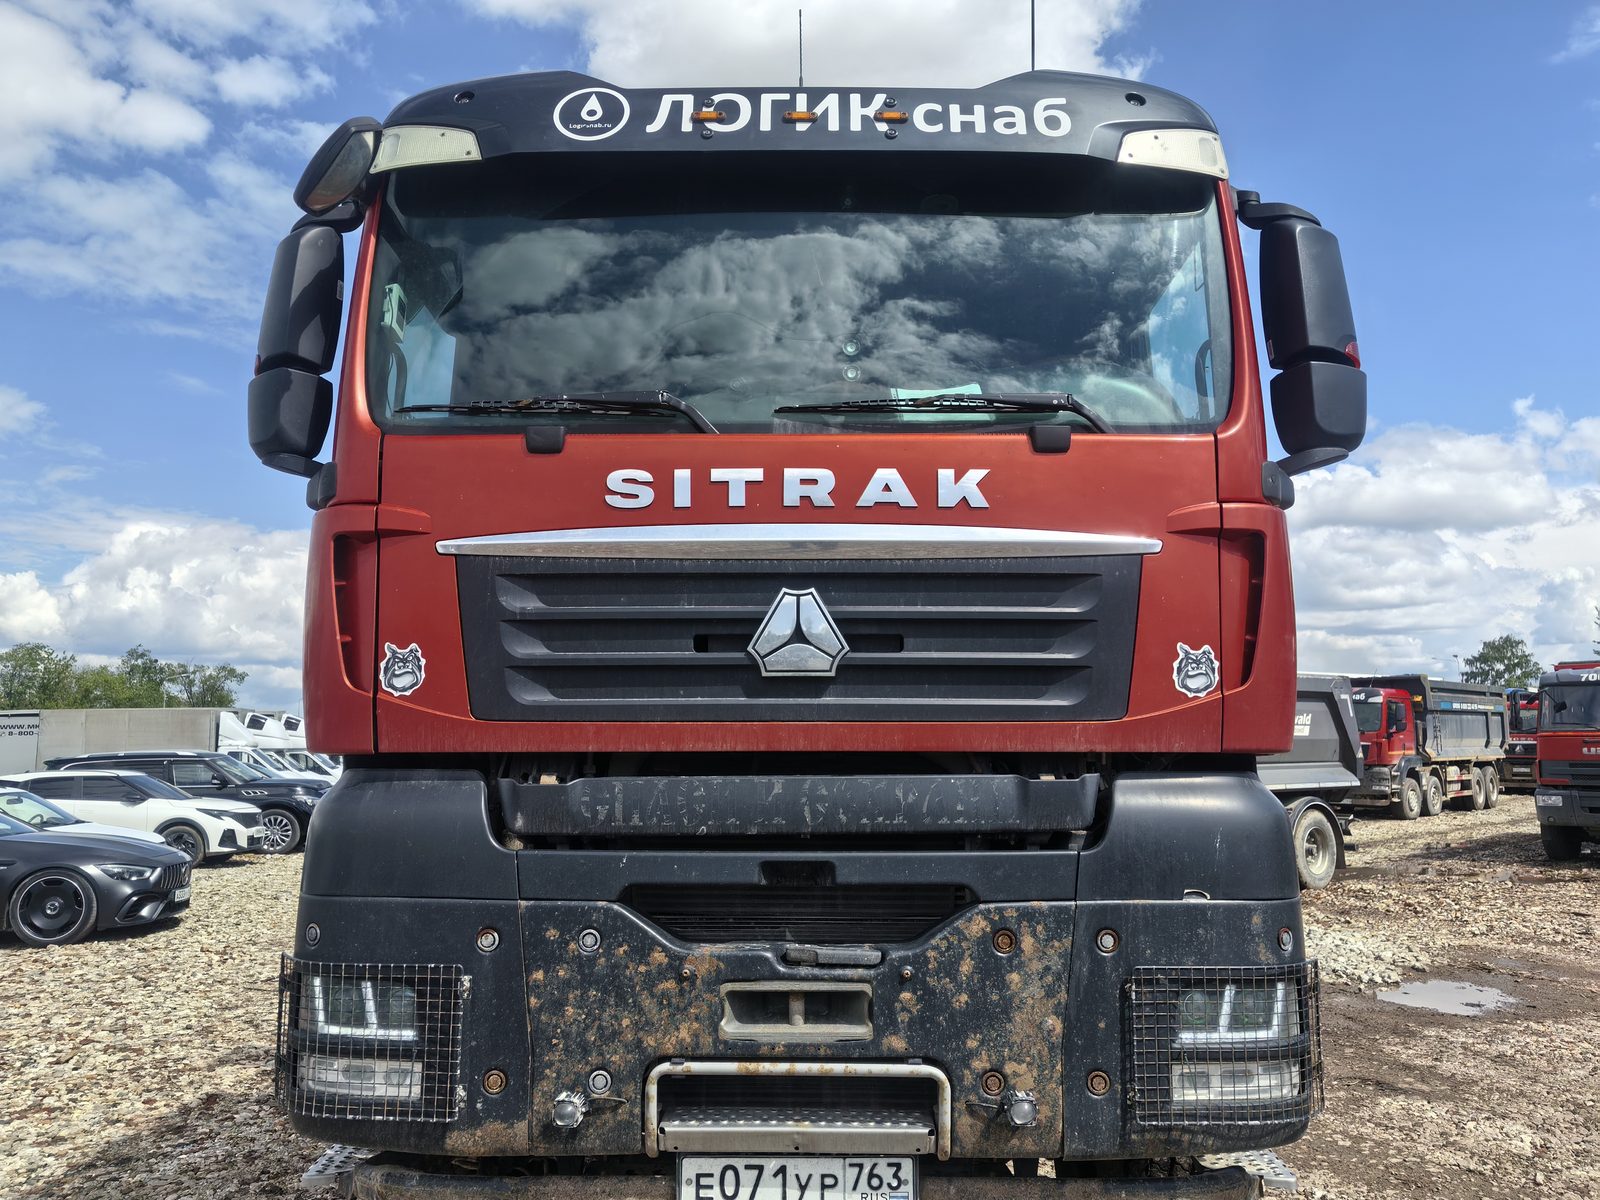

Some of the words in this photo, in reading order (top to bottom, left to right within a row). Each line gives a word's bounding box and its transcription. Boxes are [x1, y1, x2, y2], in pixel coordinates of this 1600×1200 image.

[645, 92, 889, 132] ЛОГИК
[912, 97, 1072, 137] снаб
[604, 467, 991, 509] SITRAK
[848, 1162, 902, 1191] 763
